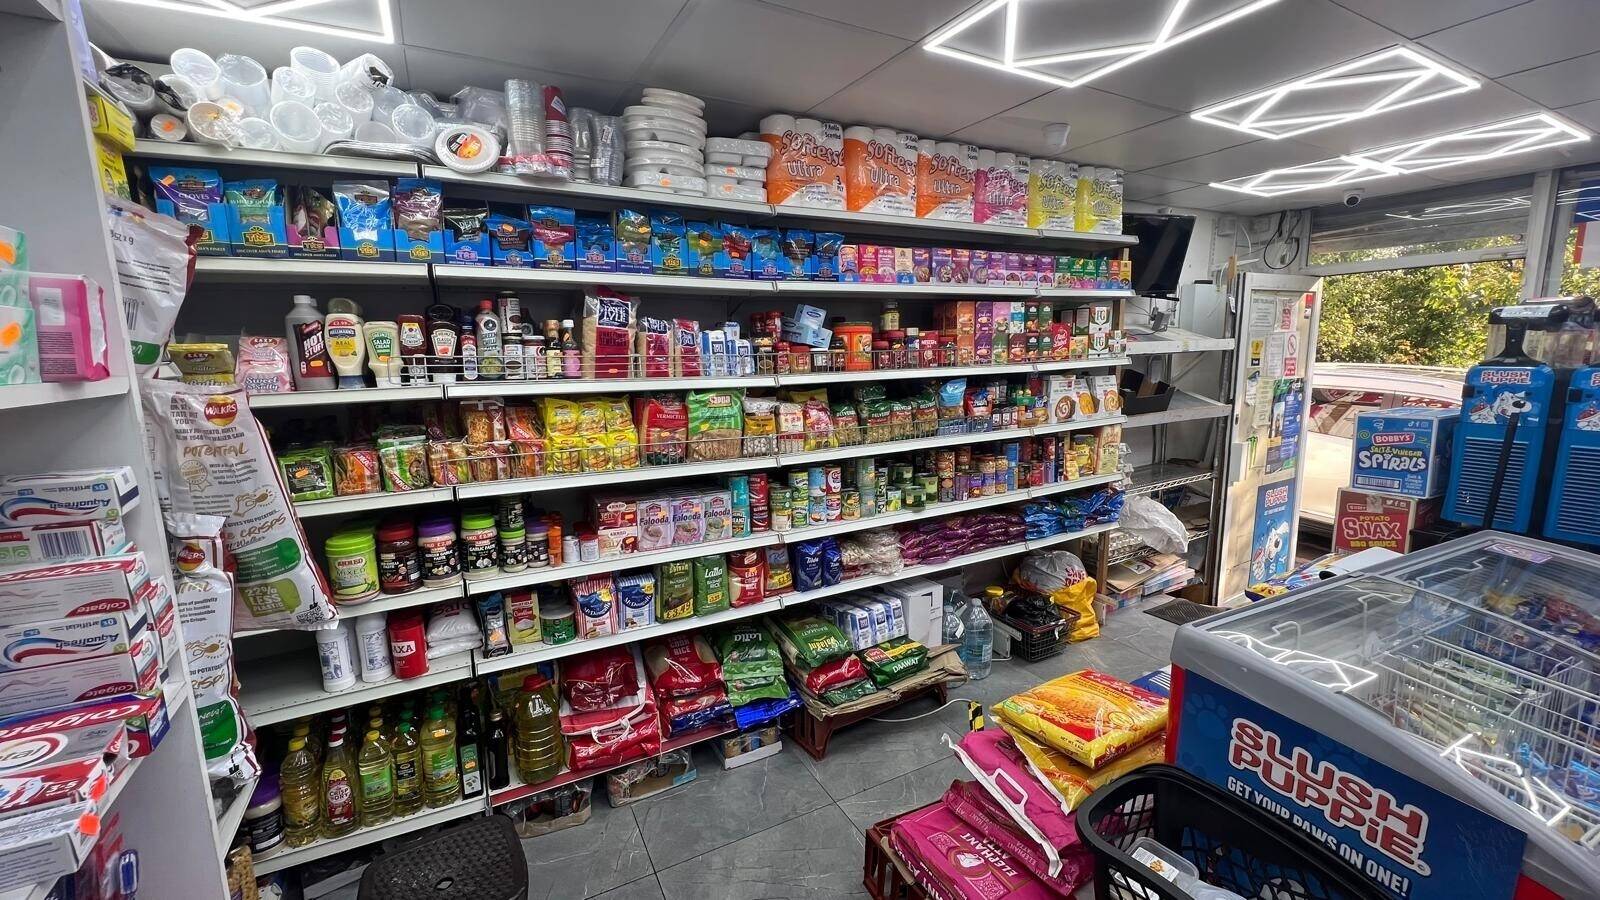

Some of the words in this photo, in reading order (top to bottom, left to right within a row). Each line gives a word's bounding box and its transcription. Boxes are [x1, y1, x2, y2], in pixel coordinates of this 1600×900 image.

[787, 160, 825, 177] Ultra
[870, 168, 900, 187] Ultra
[933, 178, 961, 194] Ultra
[303, 331, 323, 350] HOT
[305, 341, 325, 358] STUFF
[245, 376, 278, 384] Sweet
[1375, 435, 1411, 443] BOBBY'S
[57, 485, 91, 493] artificial
[50, 498, 111, 510] Aquafresh
[672, 512, 701, 522] Falooda
[704, 508, 731, 518] Falooda
[639, 516, 669, 526] Falooda
[1343, 518, 1402, 540] SNAX
[1350, 540, 1367, 548] BBQ
[1368, 540, 1397, 548] SAUCE
[336, 568, 366, 576] MIXED
[245, 586, 277, 597] 22%
[249, 594, 282, 605] LESS
[77, 601, 126, 613] Colgate
[666, 601, 691, 619] £3.49
[64, 621, 101, 631] artificial
[56, 632, 120, 649] Aquafresh
[673, 646, 692, 656] RICE
[892, 658, 919, 673] DAAWAT
[85, 684, 135, 697] Colgate
[1234, 721, 1424, 838] SLUSH
[329, 787, 350, 798] CRISP
[1227, 776, 1253, 798] GET
[1292, 814, 1338, 852] PAWS
[1339, 842, 1365, 870] ON
[1365, 859, 1412, 898] ONE!
[982, 836, 1010, 859] ATTA
[959, 832, 1019, 877] ELEPHANT
